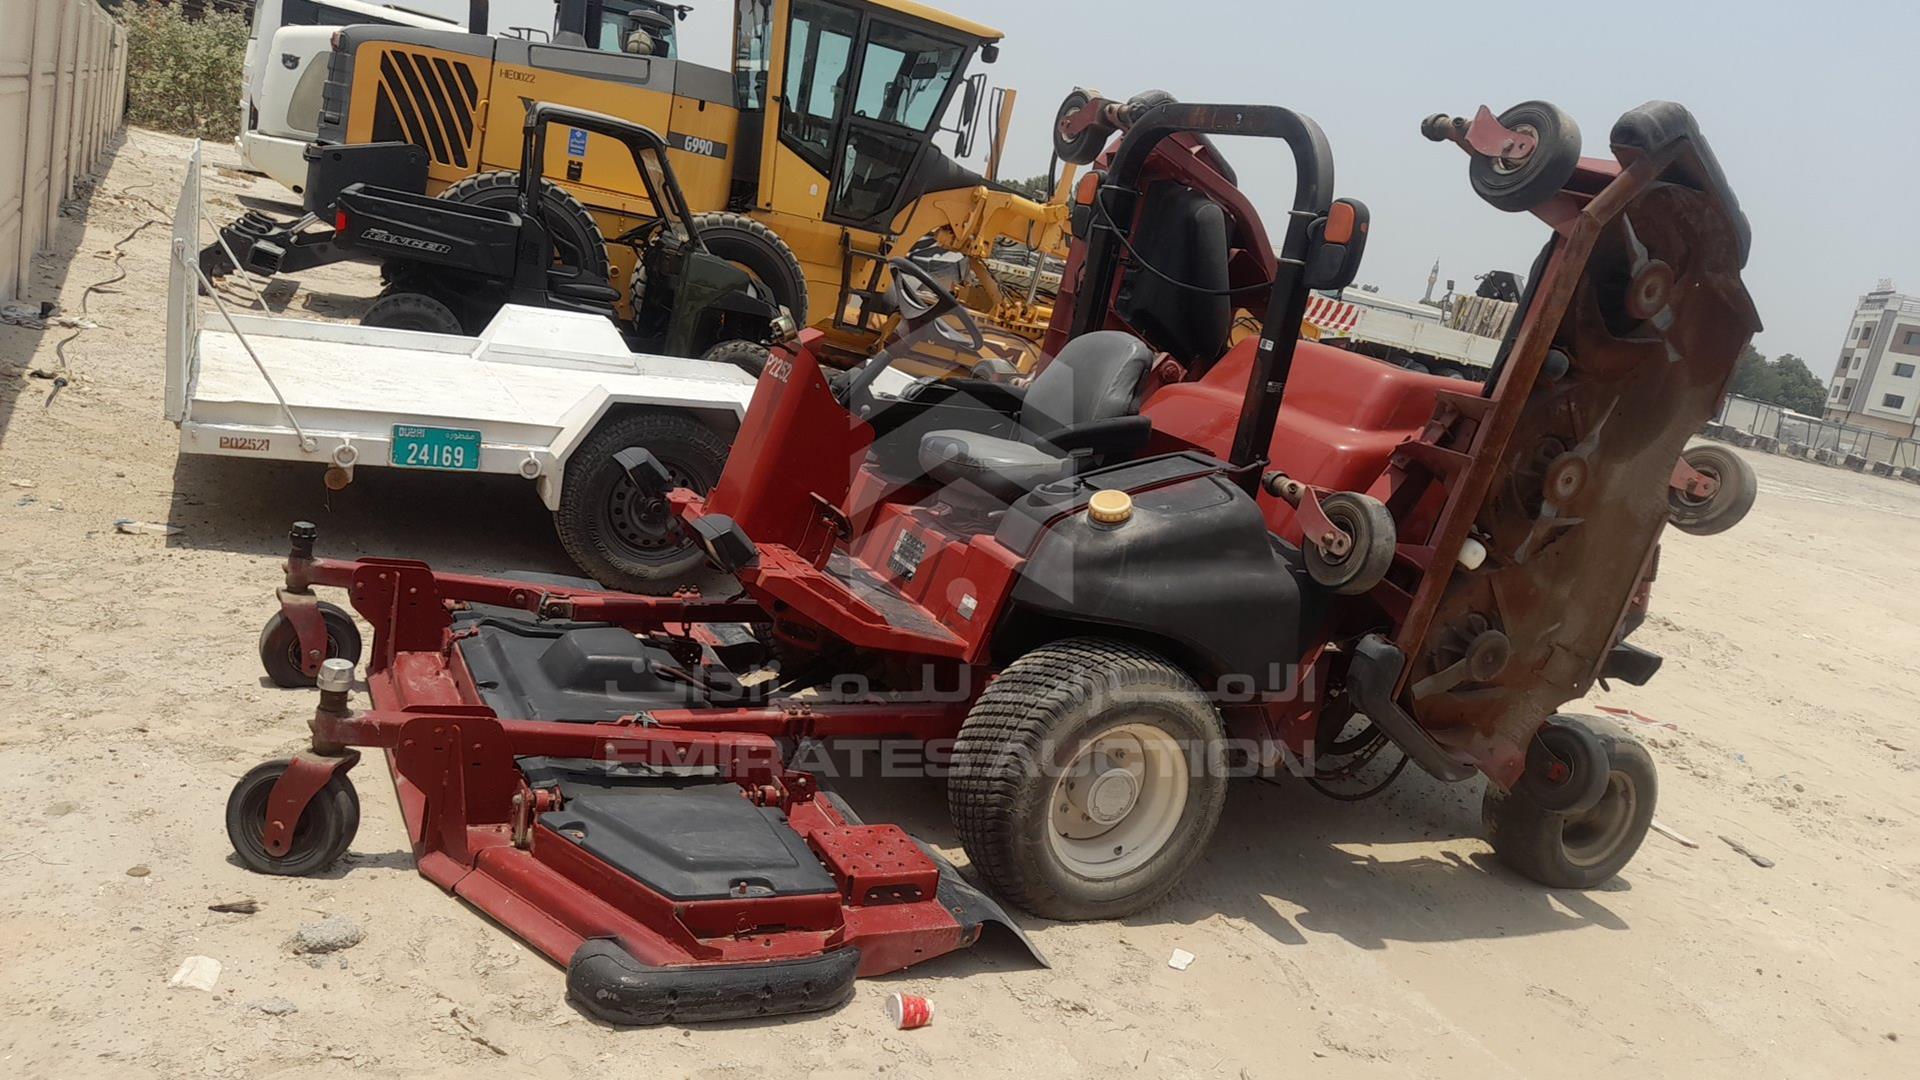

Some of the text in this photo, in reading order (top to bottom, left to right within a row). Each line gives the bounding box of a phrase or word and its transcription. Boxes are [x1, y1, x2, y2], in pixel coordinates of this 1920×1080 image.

[684, 135, 713, 156] G990
[361, 229, 452, 254] RANGER
[219, 436, 271, 451] P02521
[406, 442, 465, 467] 24169
